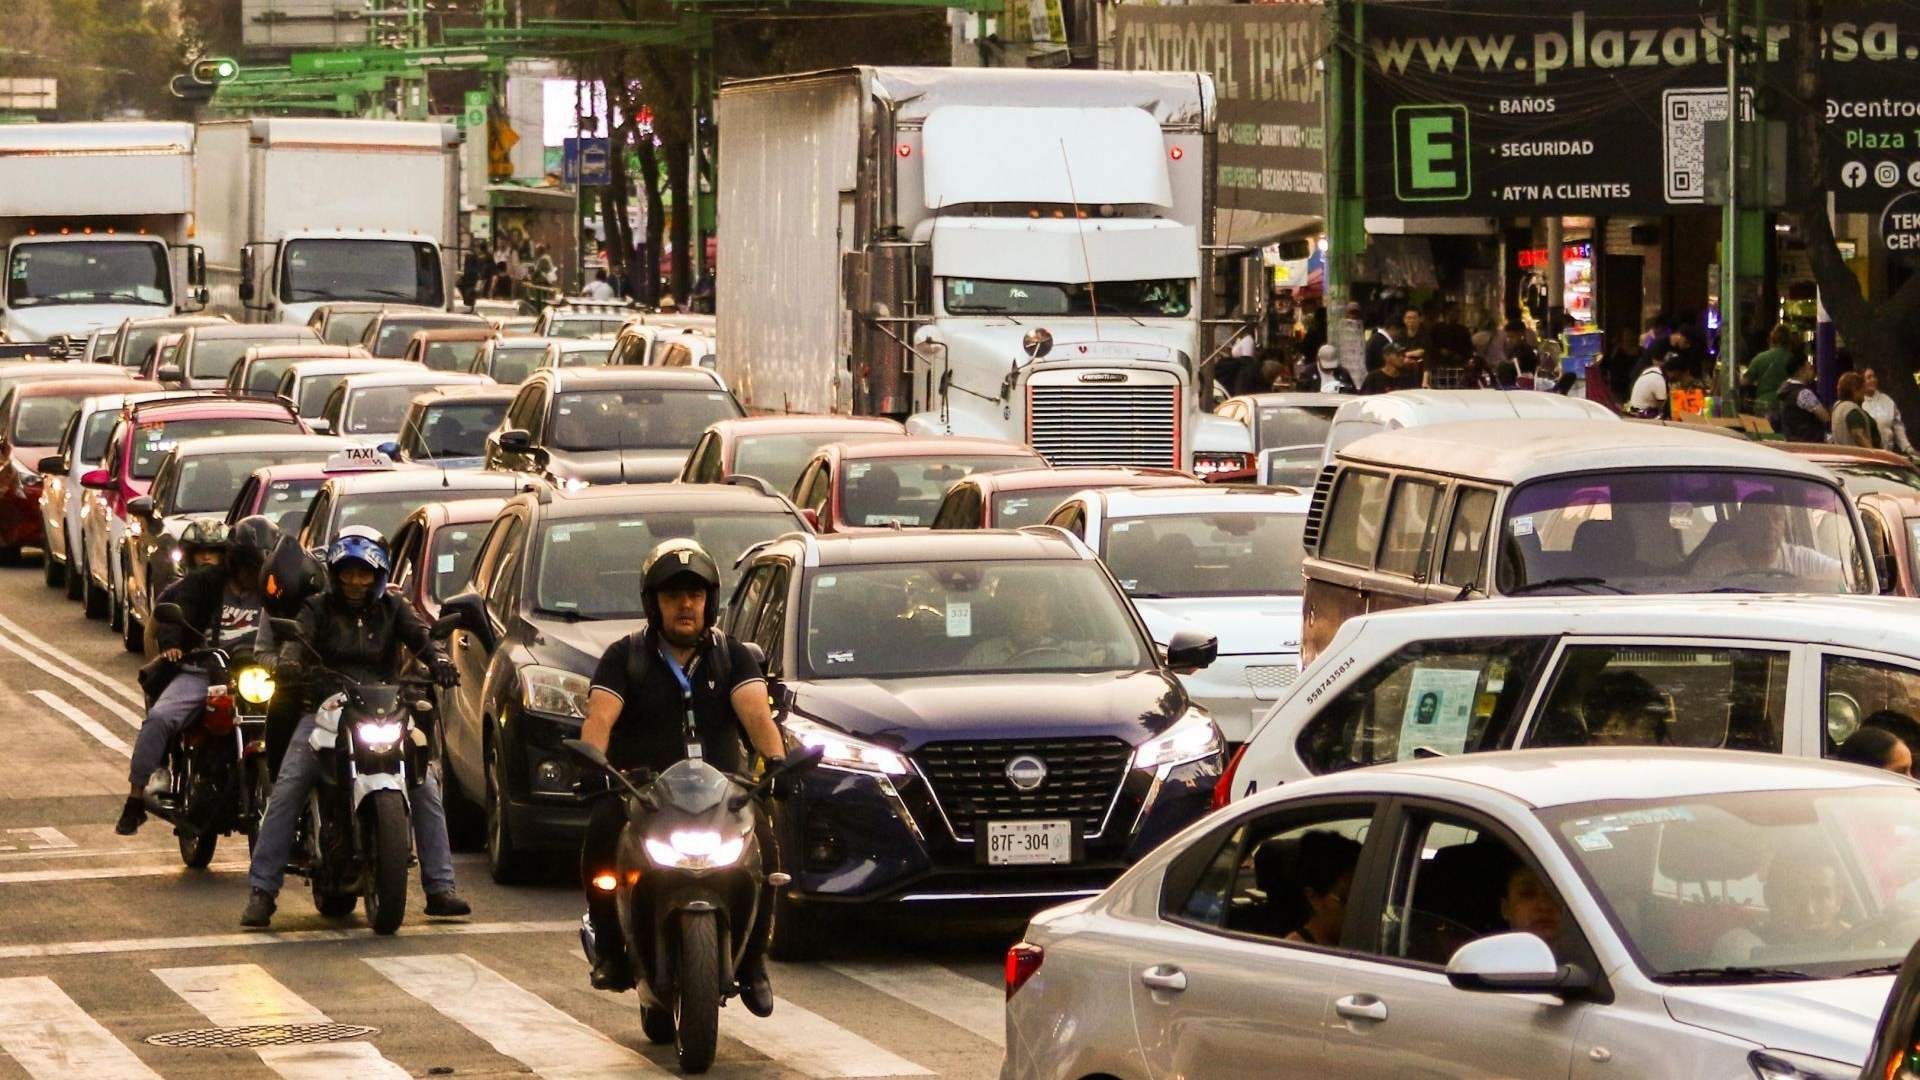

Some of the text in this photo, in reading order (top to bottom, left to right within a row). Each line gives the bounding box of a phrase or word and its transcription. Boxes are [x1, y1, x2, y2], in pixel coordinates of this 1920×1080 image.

[1370, 10, 1919, 86] www.plazatrsa.
[1122, 21, 1239, 98] CENTROCEL
[1499, 96, 1556, 114] BAÑOS
[1826, 98, 1920, 124] @centro
[1846, 128, 1905, 149] Plaza
[1409, 116, 1457, 189] E
[1501, 141, 1594, 157] SEGURIDAD
[1542, 186, 1553, 199] A
[1556, 184, 1631, 199] CLIENTES
[345, 447, 374, 460] TAXI
[991, 833, 1049, 851] 87F-304
